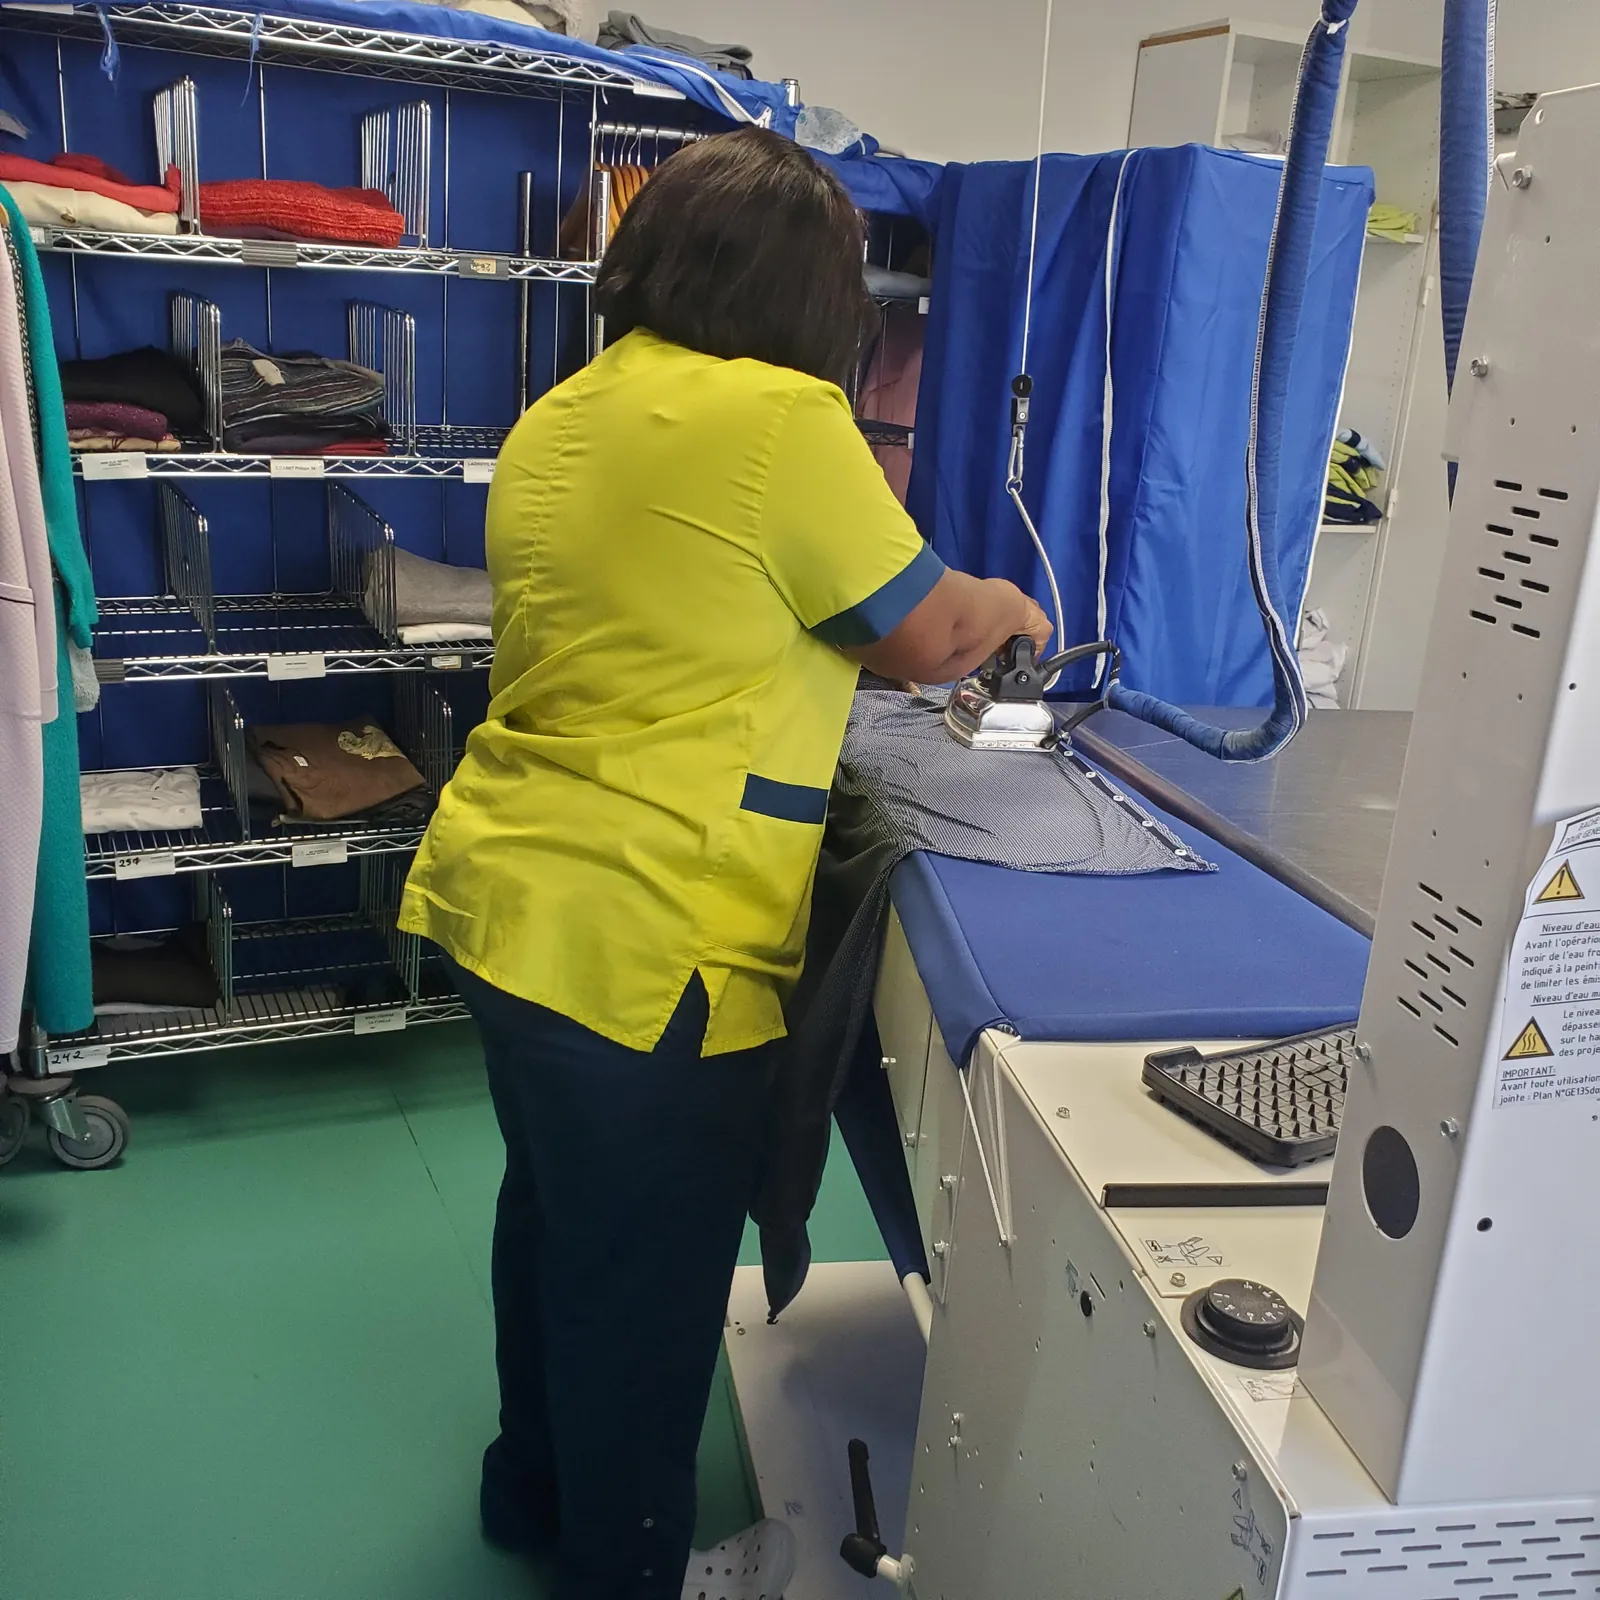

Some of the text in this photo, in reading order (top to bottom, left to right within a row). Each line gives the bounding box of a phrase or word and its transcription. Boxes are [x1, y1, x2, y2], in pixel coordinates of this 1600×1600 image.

[1541, 921, 1600, 933] Niveau d'eau
[1525, 935, 1600, 950] Avant l'opératio
[1523, 952, 1546, 964] avoir
[1548, 951, 1560, 961] de
[1562, 950, 1585, 960] l'eau
[1521, 964, 1553, 977] indiqué
[1556, 964, 1561, 973] à
[1564, 964, 1572, 972] la
[1520, 980, 1531, 990] de
[1533, 978, 1563, 989] limiter
[1565, 976, 1580, 986] les
[1532, 994, 1562, 1004] Niveau
[1564, 991, 1589, 1001] d'eau
[1563, 1010, 1574, 1019] Le
[1560, 1036, 1575, 1044] sur
[1578, 1034, 1586, 1042] le
[51, 1050, 84, 1064] 242
[1558, 1048, 1574, 1057] des
[1502, 1065, 1556, 1079] IMPORTANT:
[1500, 1081, 1527, 1092] Avant
[1530, 1079, 1554, 1089] toute
[1499, 1093, 1525, 1106] jointe
[1532, 1091, 1553, 1101] Plan
